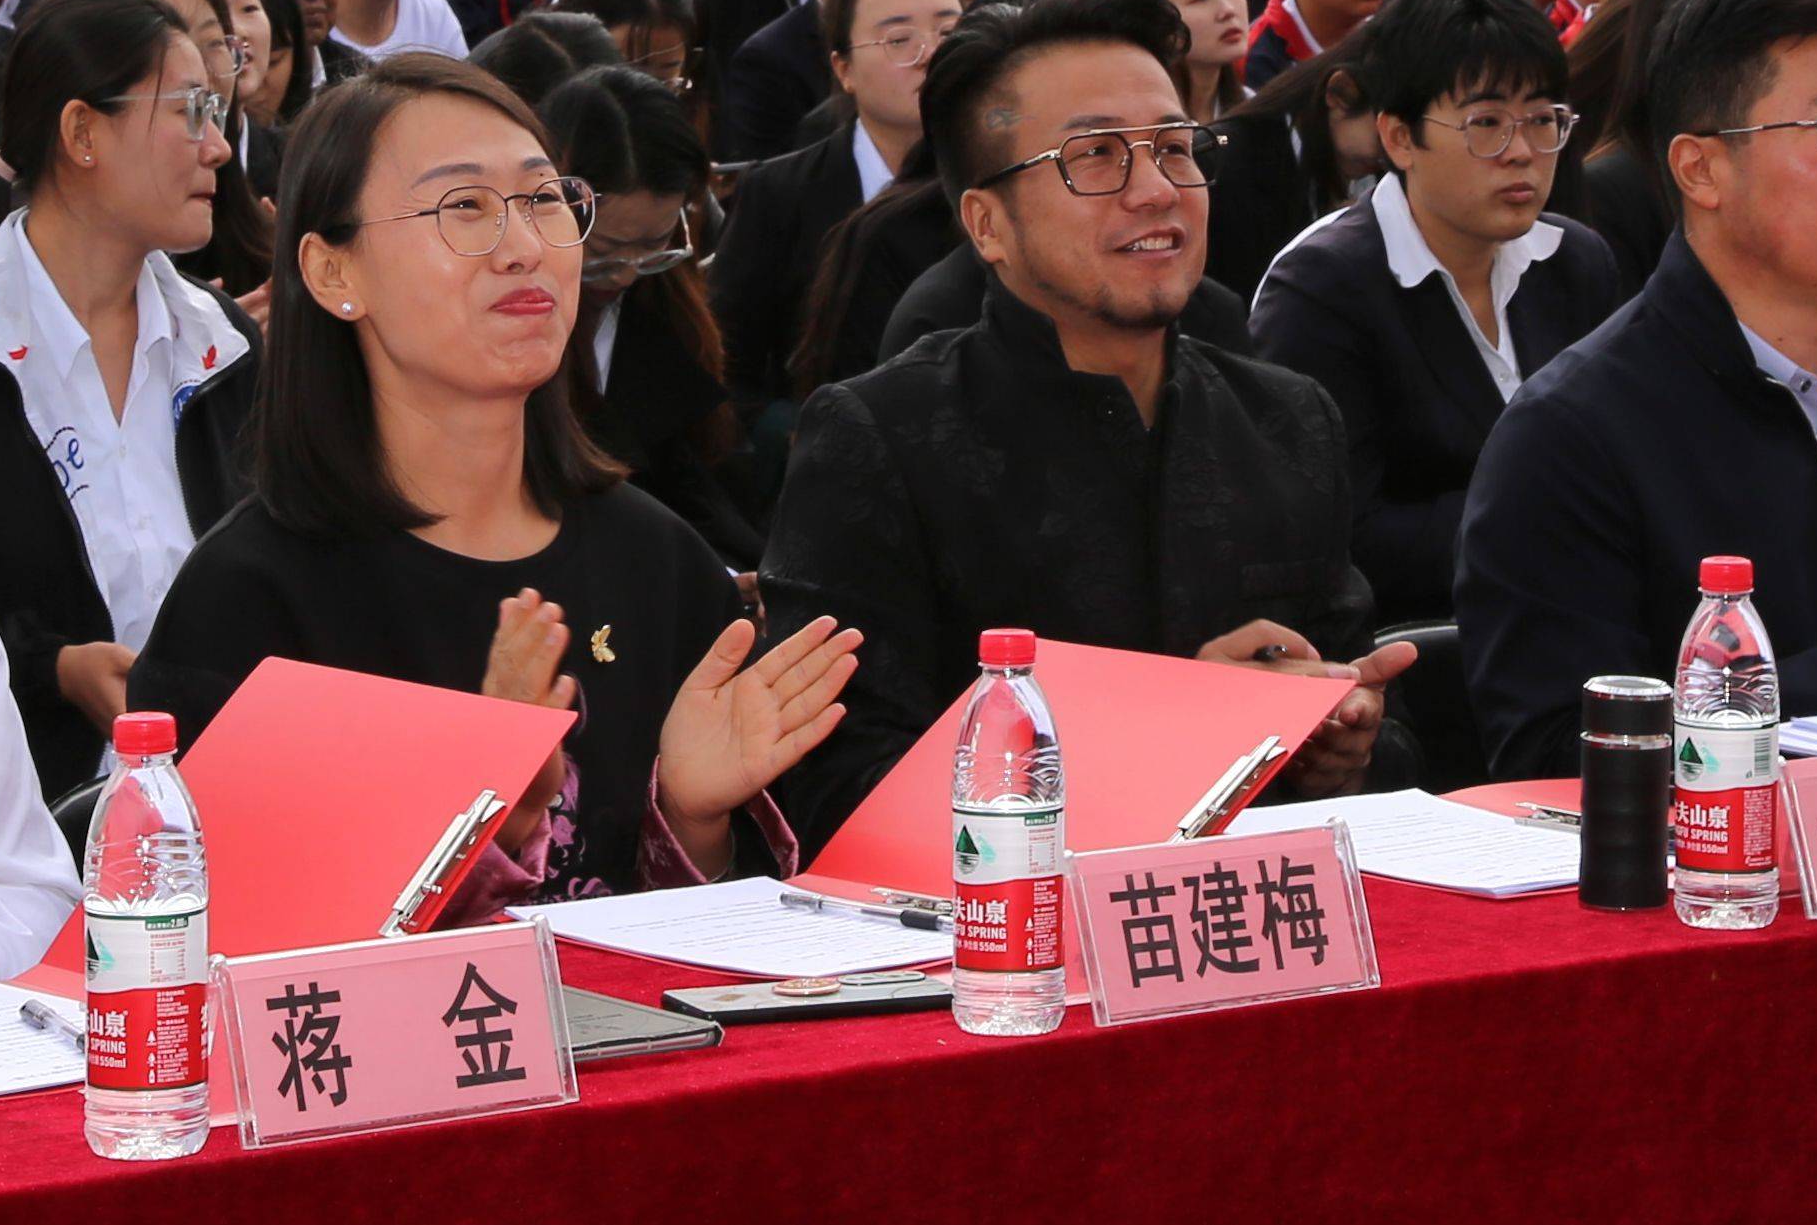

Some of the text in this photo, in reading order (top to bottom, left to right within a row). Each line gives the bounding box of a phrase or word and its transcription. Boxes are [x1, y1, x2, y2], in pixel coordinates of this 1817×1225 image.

[1691, 828, 1728, 842] SPRING
[1109, 856, 1330, 988] 苗建梅
[968, 926, 1007, 939] SPRING
[91, 1038, 126, 1054] SPRING
